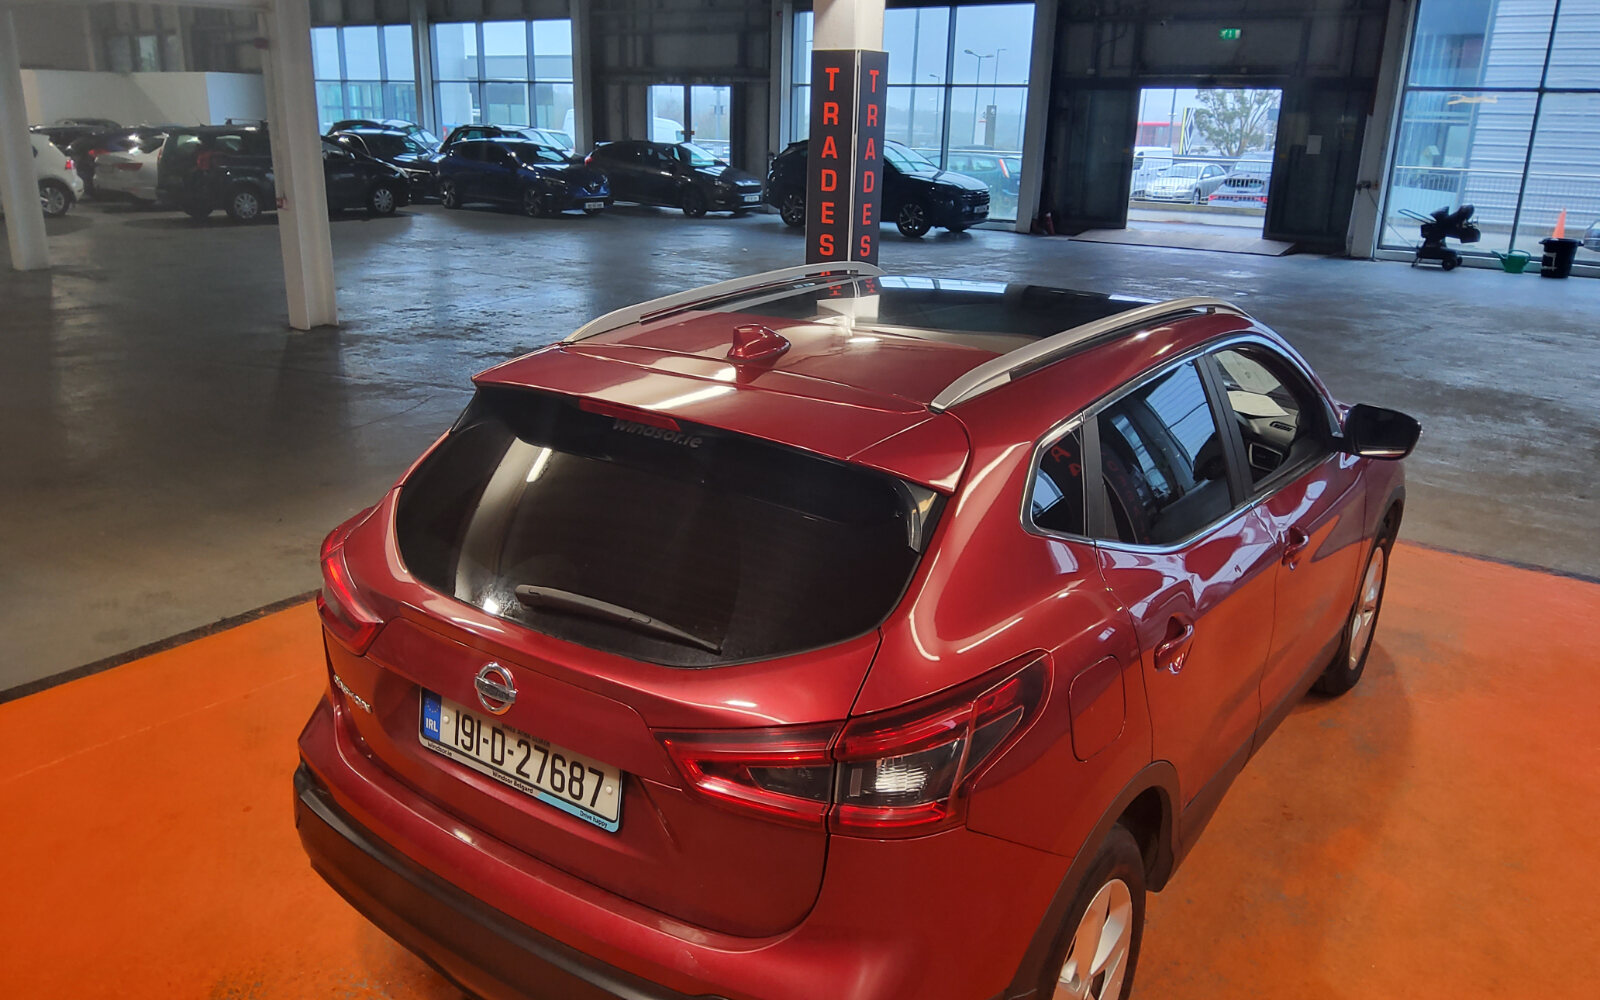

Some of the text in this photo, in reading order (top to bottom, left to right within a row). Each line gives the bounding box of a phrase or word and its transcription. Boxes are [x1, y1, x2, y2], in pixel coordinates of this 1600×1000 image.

[819, 67, 840, 256] TRADES
[860, 69, 879, 257] TRADES
[425, 717, 439, 733] IRL
[454, 709, 605, 808] 191-D-27687
